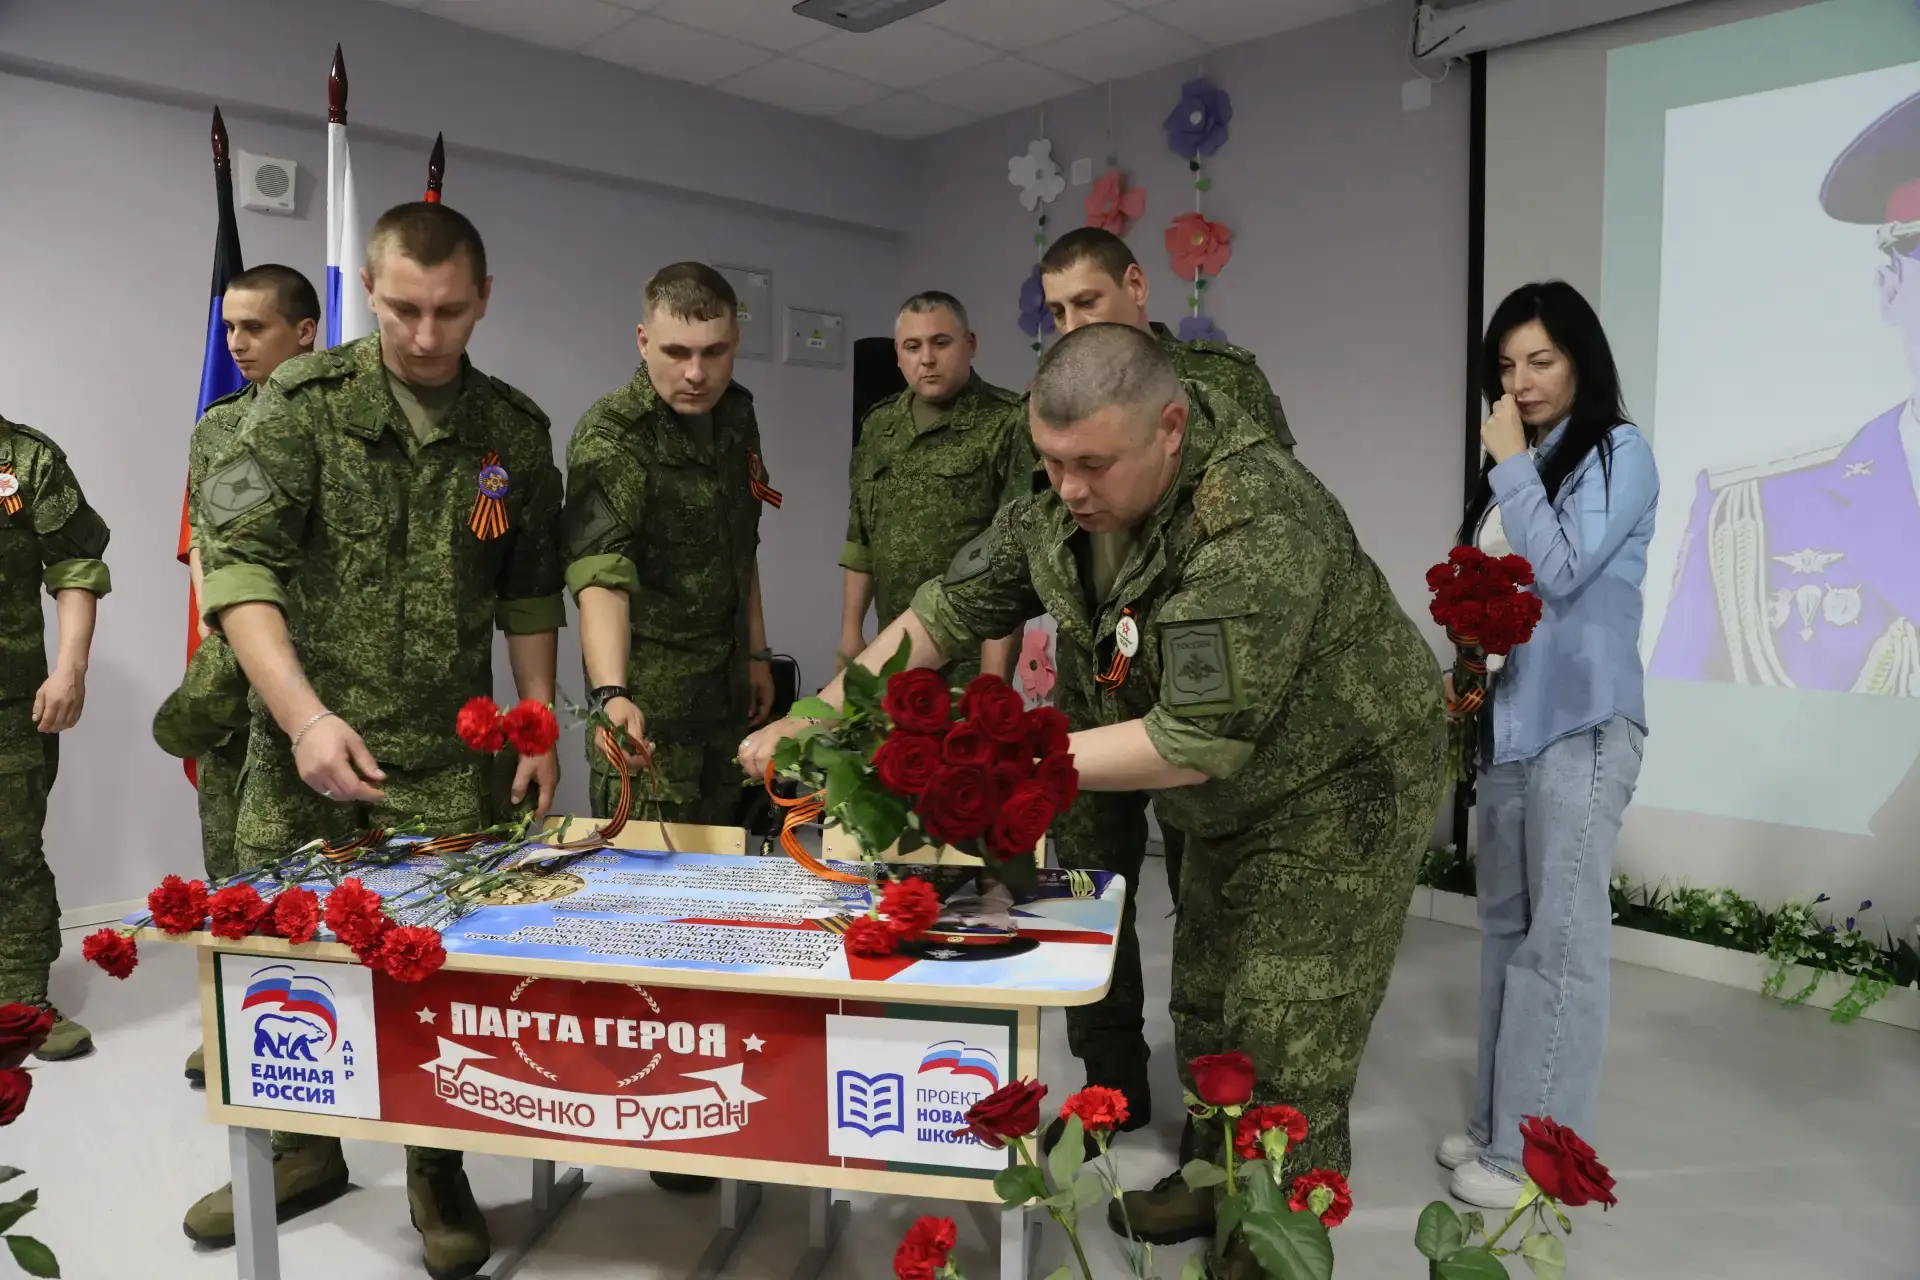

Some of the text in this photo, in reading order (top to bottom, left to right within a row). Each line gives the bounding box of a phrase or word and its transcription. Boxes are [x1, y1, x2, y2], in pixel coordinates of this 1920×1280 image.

[450, 1002, 726, 1057] ПАРТА ГЕРОЯ
[251, 1063, 334, 1085] ЕДИНАЯ
[252, 1081, 335, 1105] РОССИЯ
[435, 1063, 747, 1140] Бевзенко Руслан
[916, 1088, 981, 1106] ПРОЕКТ
[917, 1107, 970, 1125] НОВА
